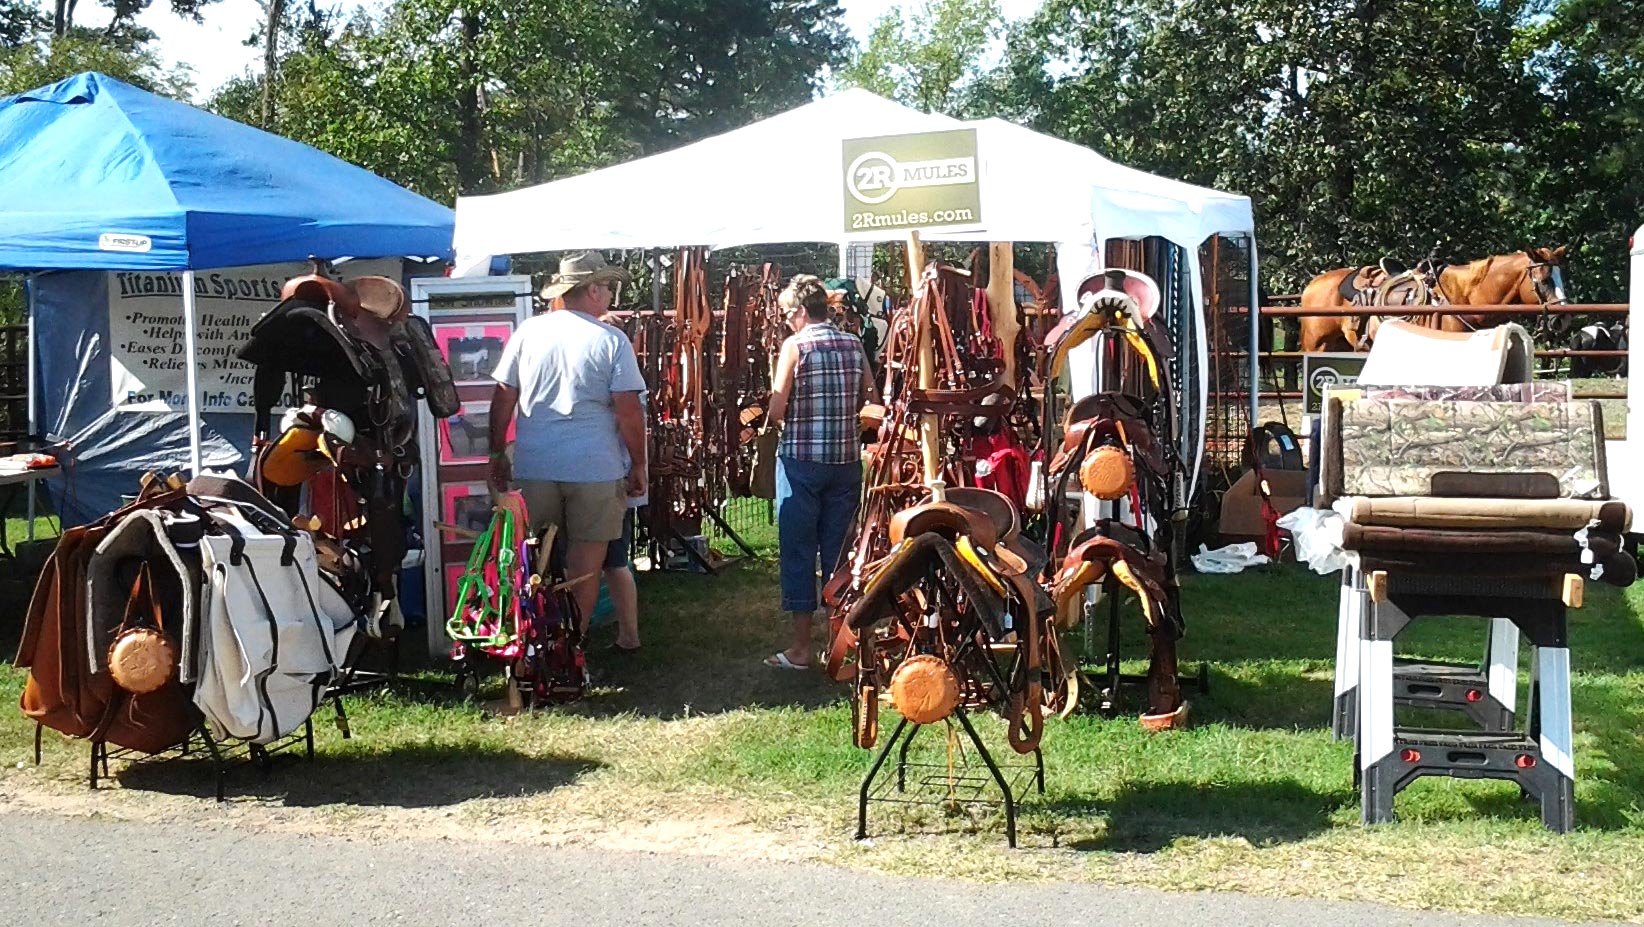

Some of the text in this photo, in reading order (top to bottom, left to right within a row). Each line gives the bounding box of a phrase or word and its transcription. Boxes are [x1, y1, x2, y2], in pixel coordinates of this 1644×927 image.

[855, 163, 968, 190] 2R MULES
[852, 208, 973, 229] 2Rmules.com
[209, 273, 281, 299] Sports
[201, 314, 250, 327] Health
[127, 341, 166, 354] Eases
[127, 390, 155, 404] For
[159, 390, 188, 406] Mor
